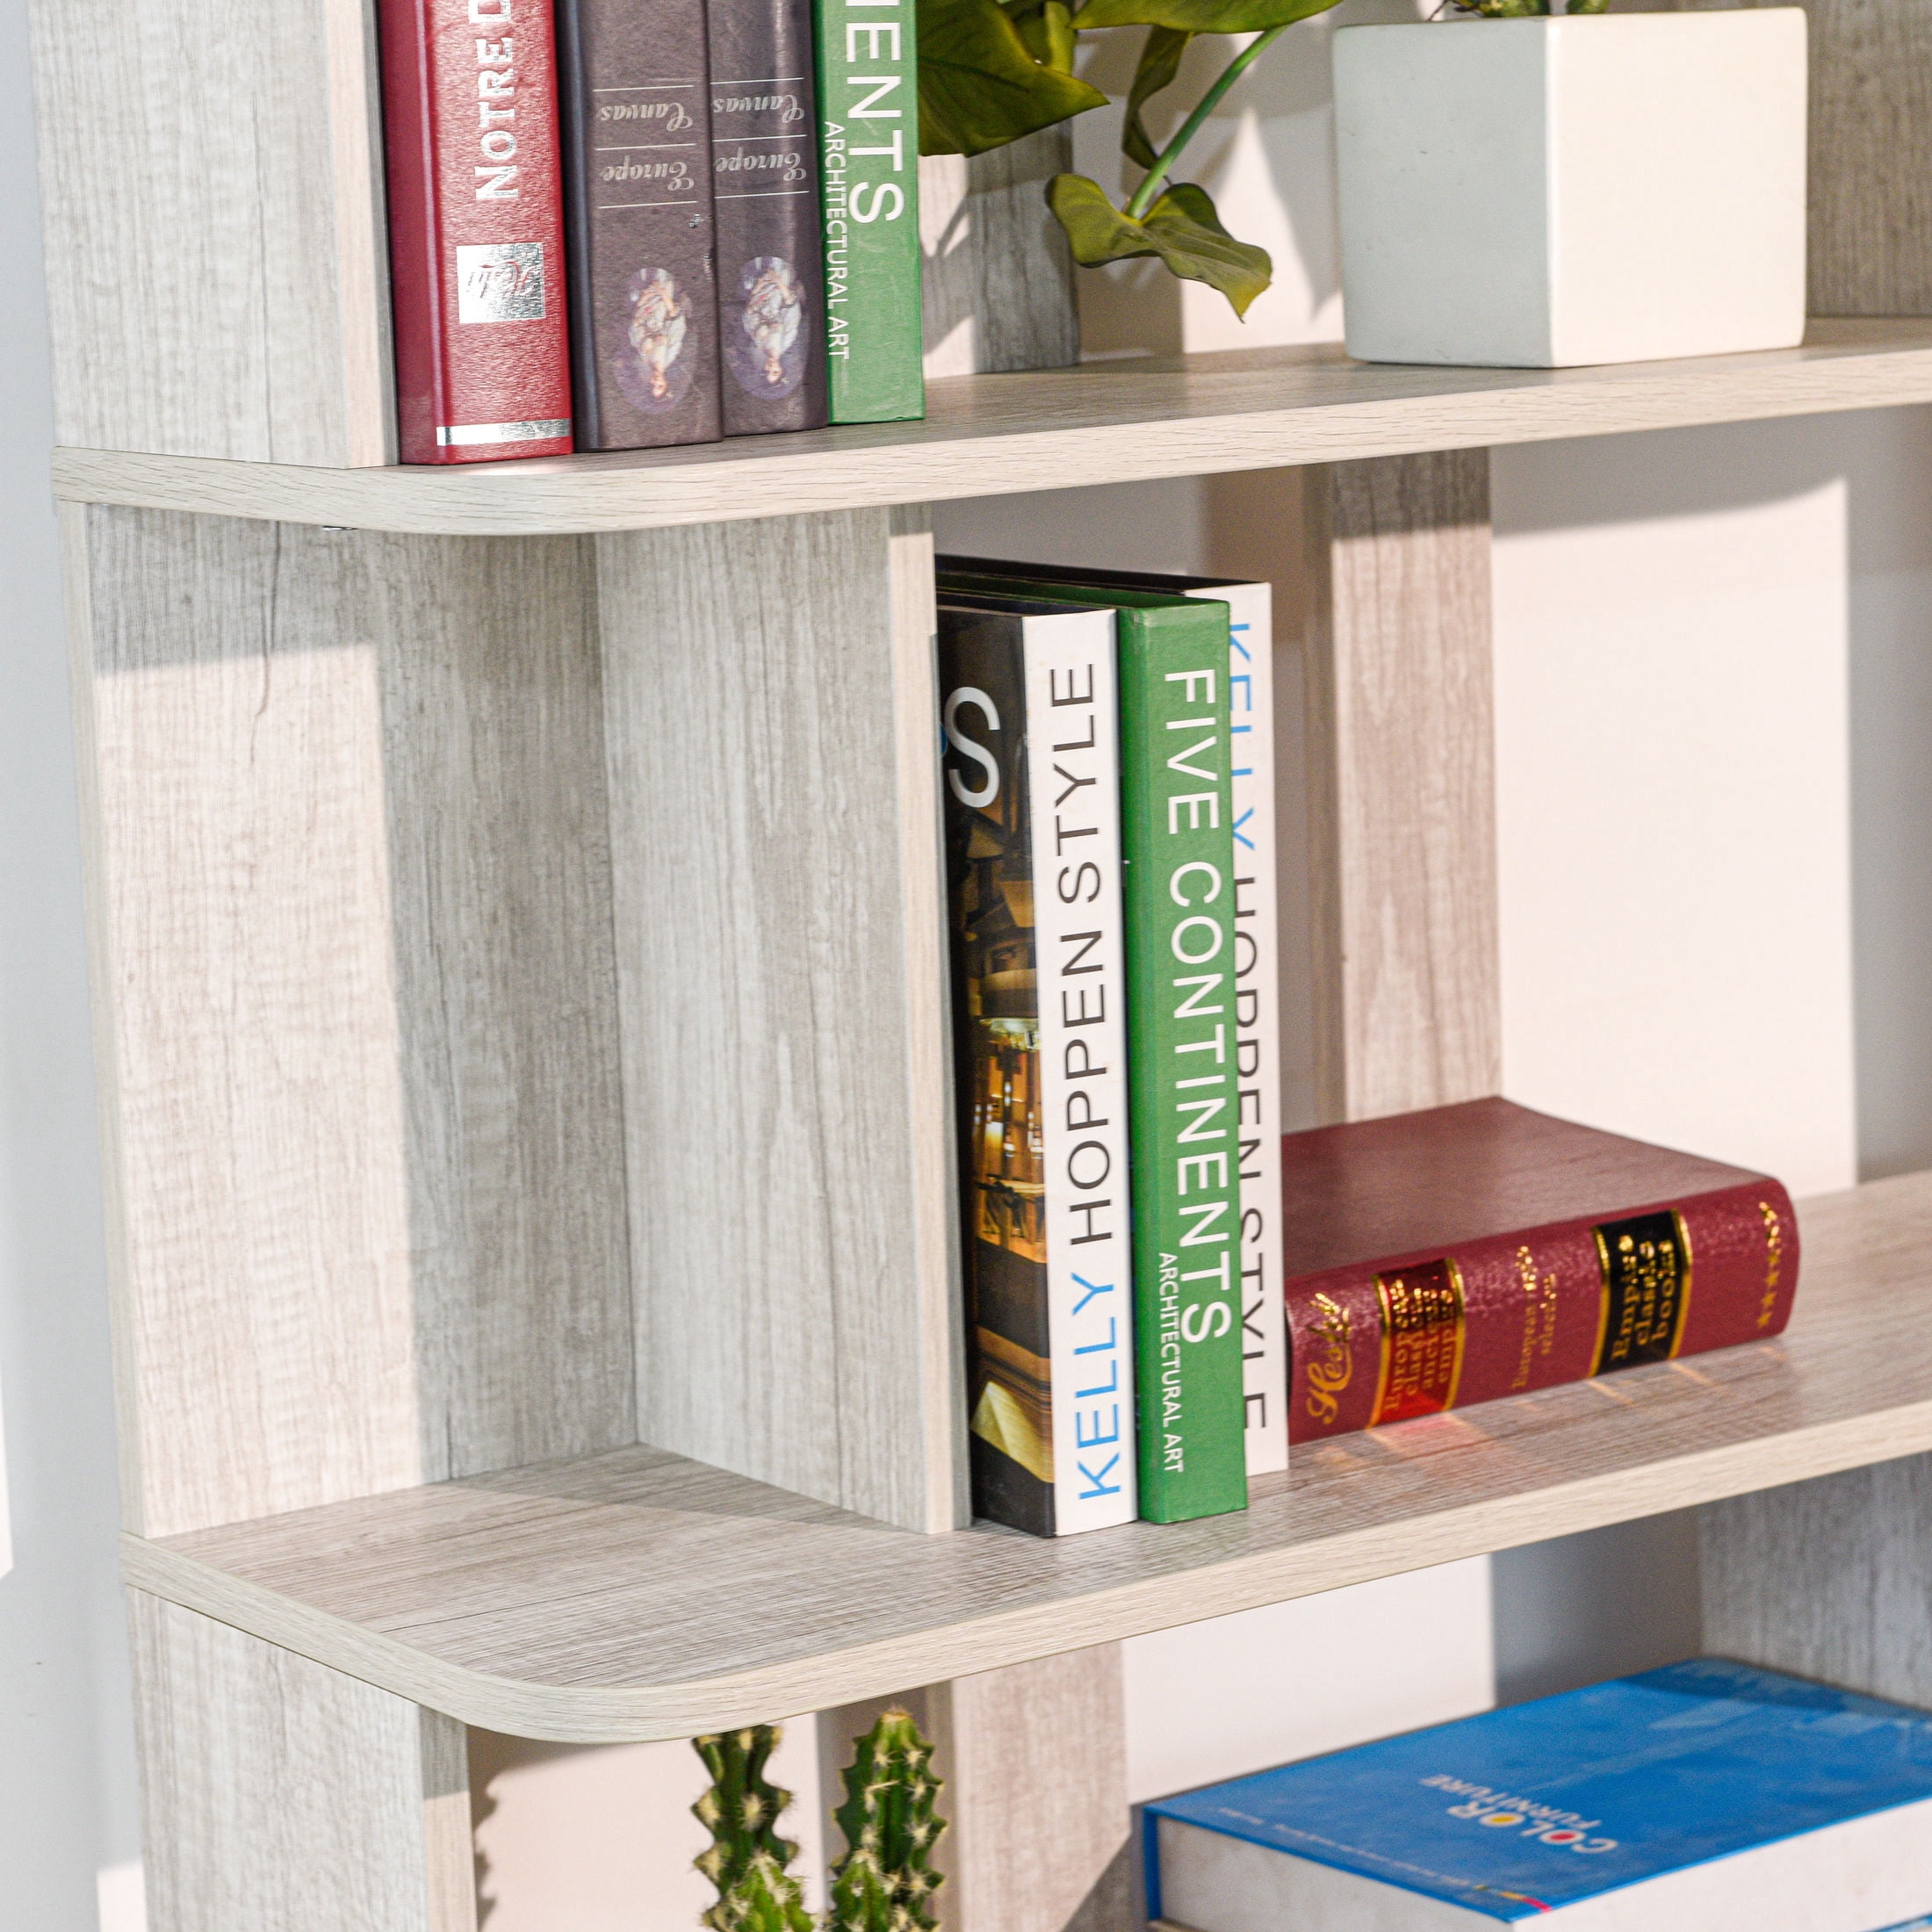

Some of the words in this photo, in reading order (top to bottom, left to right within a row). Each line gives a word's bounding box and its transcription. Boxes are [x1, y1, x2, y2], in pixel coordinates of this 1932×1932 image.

[473, 37, 519, 200] NOTRE
[598, 102, 693, 132] Canvas
[602, 155, 695, 191] Europe
[710, 94, 805, 124] Canvas
[714, 146, 807, 181] Europe
[845, 0, 905, 224] ENTS
[825, 121, 848, 309] ARCHITECTURAL
[828, 316, 849, 360] ART
[943, 686, 1001, 809] S
[1049, 664, 1101, 905] STYLE
[1164, 669, 1221, 835] FIVE
[1059, 929, 1113, 1246] HOPPEN
[1169, 861, 1232, 1344] CONTINENTS
[1071, 1272, 1121, 1501] KELLY
[1158, 1252, 1182, 1428] ARCHITECTURAL
[1163, 1434, 1184, 1473] ART
[1447, 1801, 1618, 1854] COLOR
